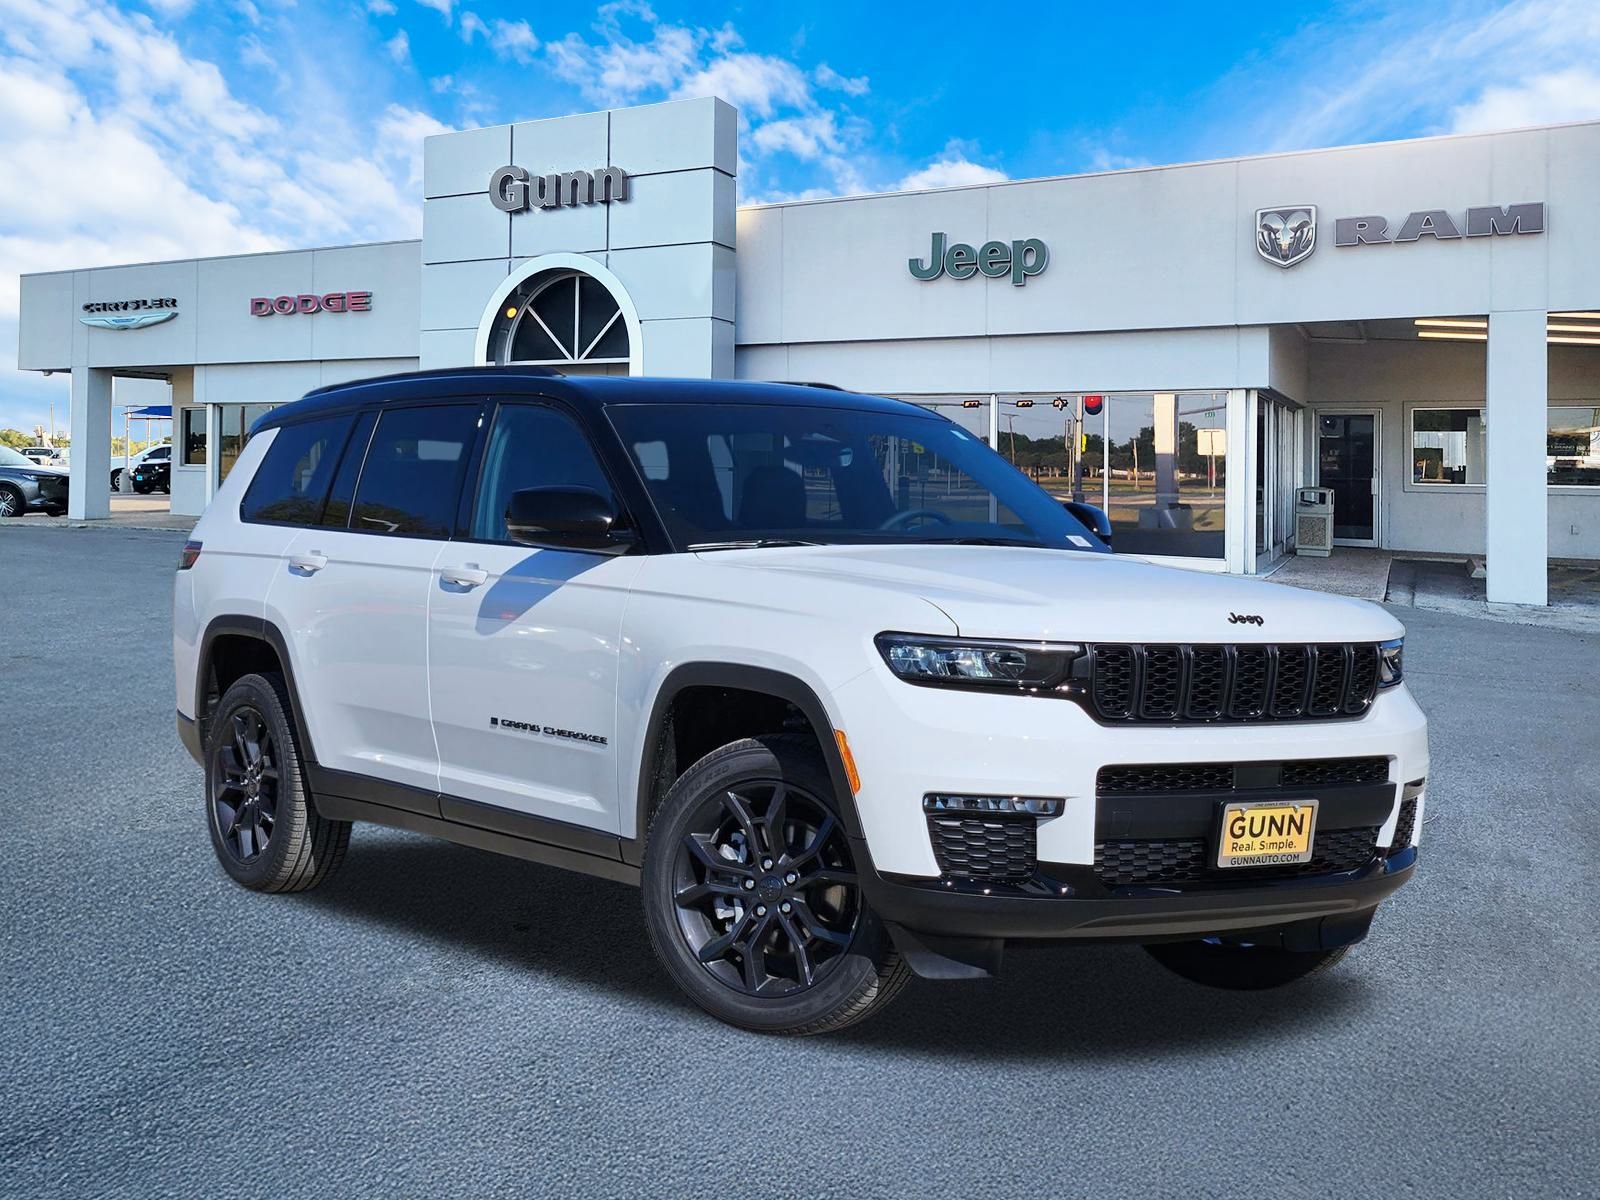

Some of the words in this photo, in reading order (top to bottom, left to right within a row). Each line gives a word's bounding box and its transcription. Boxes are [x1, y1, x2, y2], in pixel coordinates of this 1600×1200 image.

[489, 165, 628, 213] Gunn
[1335, 201, 1545, 248] RAM
[908, 231, 1050, 287] Jeep
[82, 297, 178, 314] CHRYSLER
[250, 291, 373, 317] DODGE
[1227, 611, 1265, 627] Jeep
[501, 719, 541, 733] GRAND
[543, 726, 608, 746] CHEROKEE
[1229, 812, 1305, 840] GUNN
[1231, 841, 1256, 853] Real.
[1258, 838, 1297, 852] Simple.
[1230, 853, 1300, 866] GUNNAUTO.COM
